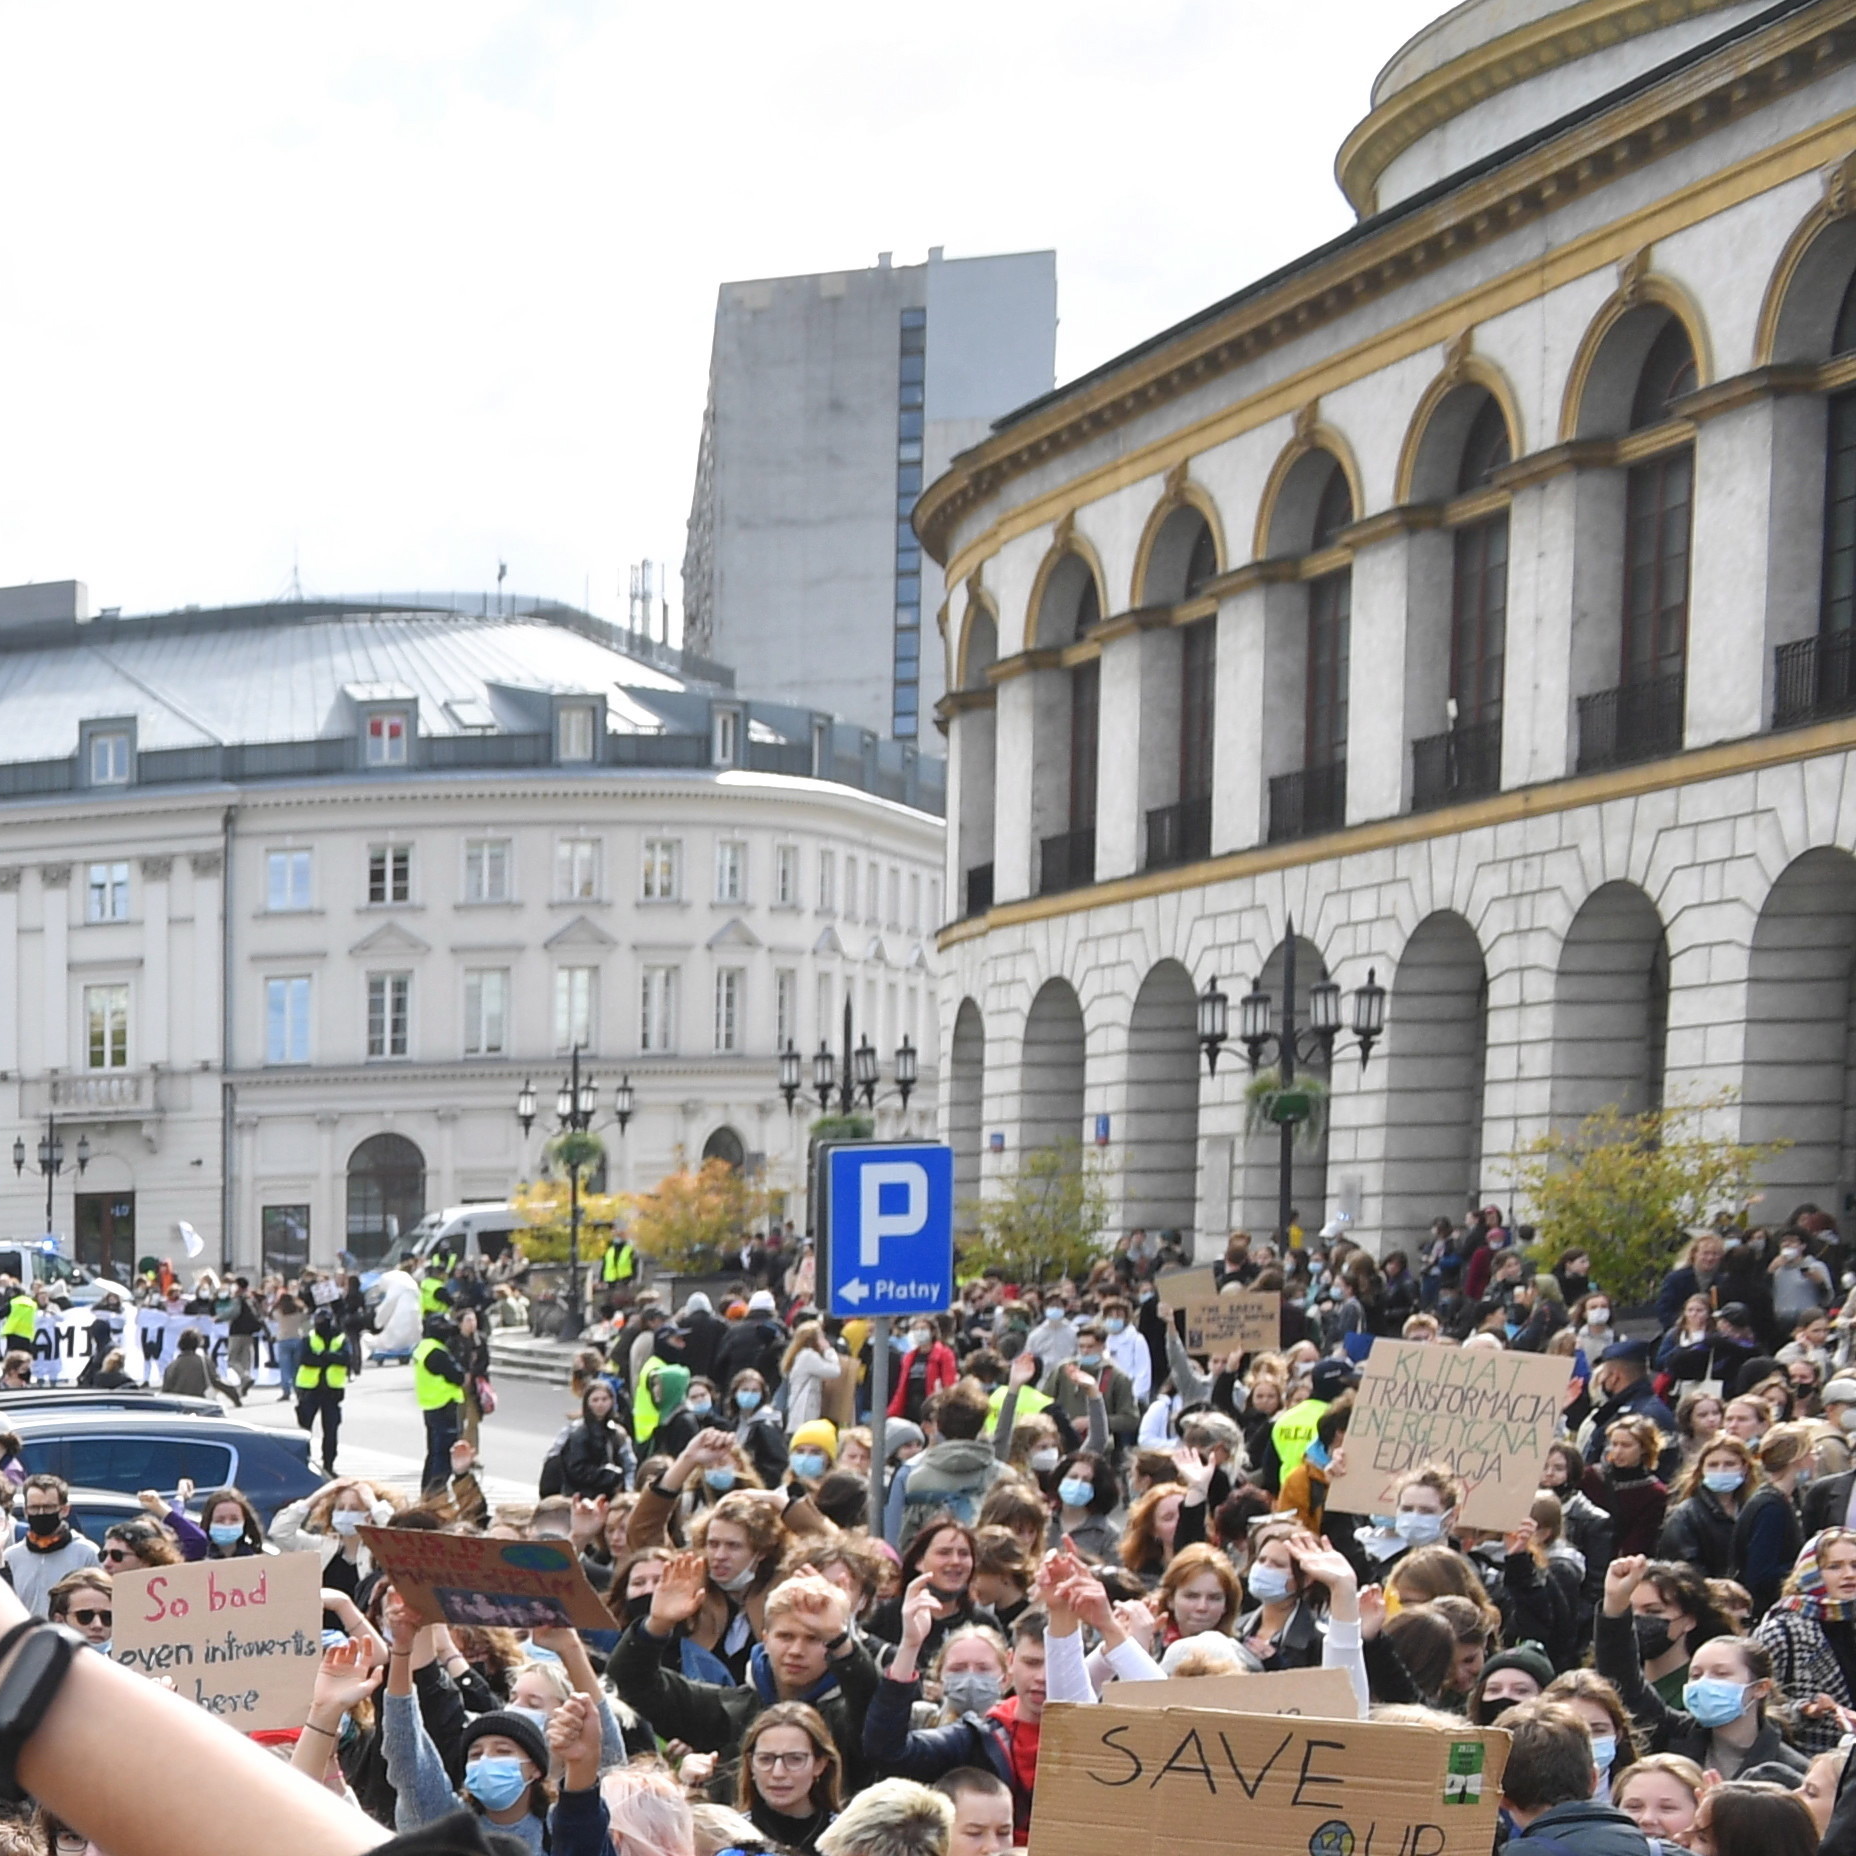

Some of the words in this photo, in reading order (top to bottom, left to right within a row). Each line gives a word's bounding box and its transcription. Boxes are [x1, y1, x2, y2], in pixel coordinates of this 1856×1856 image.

[860, 1161, 928, 1266] P
[875, 1279, 940, 1304] Płatny
[1393, 1349, 1532, 1392] KLIMAT
[1366, 1376, 1557, 1426] TRANSFORMACJA
[1349, 1406, 1538, 1459] ENERGETYCZNA
[144, 1577, 189, 1622] So
[208, 1569, 266, 1612] bad
[195, 1679, 260, 1714] here
[1086, 1726, 1346, 1809] SAVE
